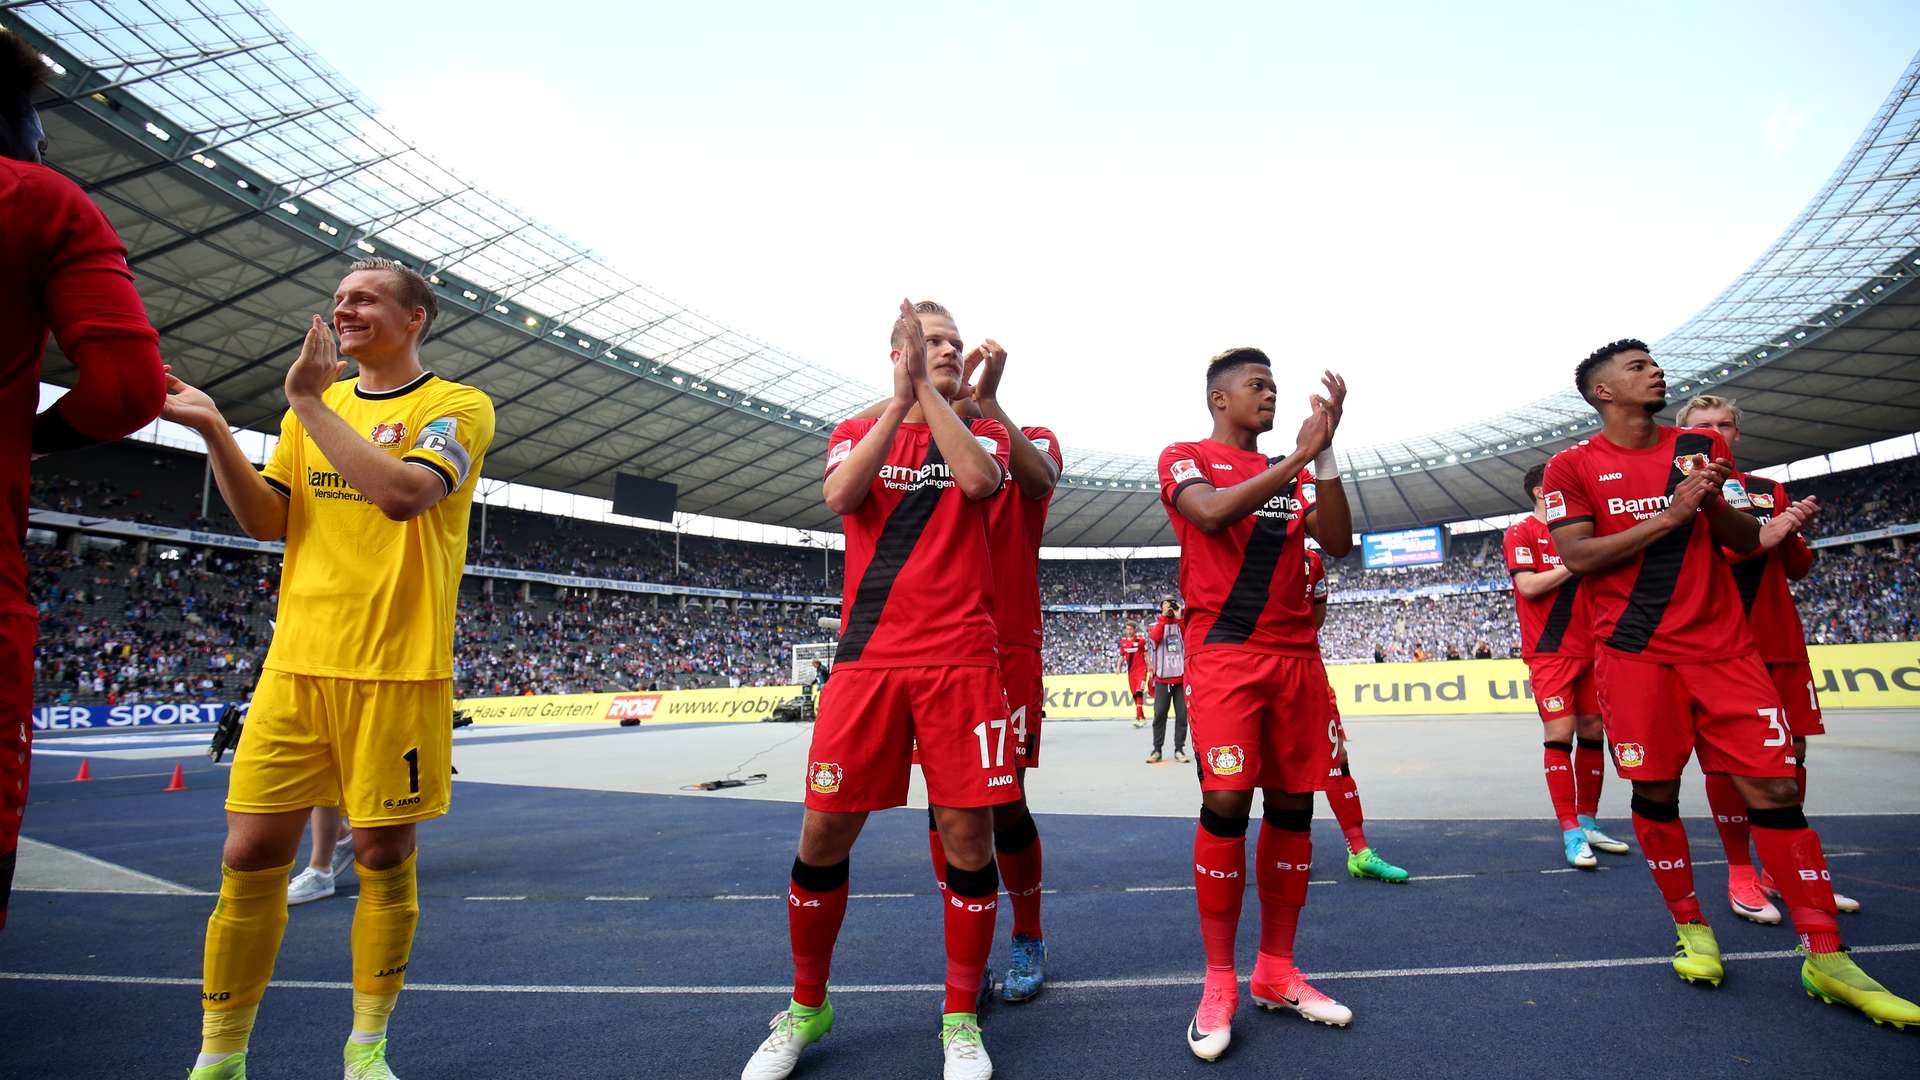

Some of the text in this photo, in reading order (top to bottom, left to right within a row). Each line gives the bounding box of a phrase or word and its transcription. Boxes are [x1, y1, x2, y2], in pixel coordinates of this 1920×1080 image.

[423, 434, 447, 450] C
[878, 461, 955, 482] armeni
[1599, 472, 1623, 481] JAKO
[1542, 553, 1563, 564] Bar
[1355, 675, 1467, 702] rund
[106, 703, 224, 726] SPORT
[472, 704, 507, 718] Haus
[510, 704, 539, 717] und
[541, 702, 600, 717] Garten!
[1011, 705, 1027, 742] 4
[973, 719, 1007, 769] 17
[1328, 720, 1339, 760] 9
[402, 747, 420, 793] 1
[987, 775, 1014, 787] JAKO
[397, 797, 421, 807] JAKO
[789, 888, 821, 907] 04
